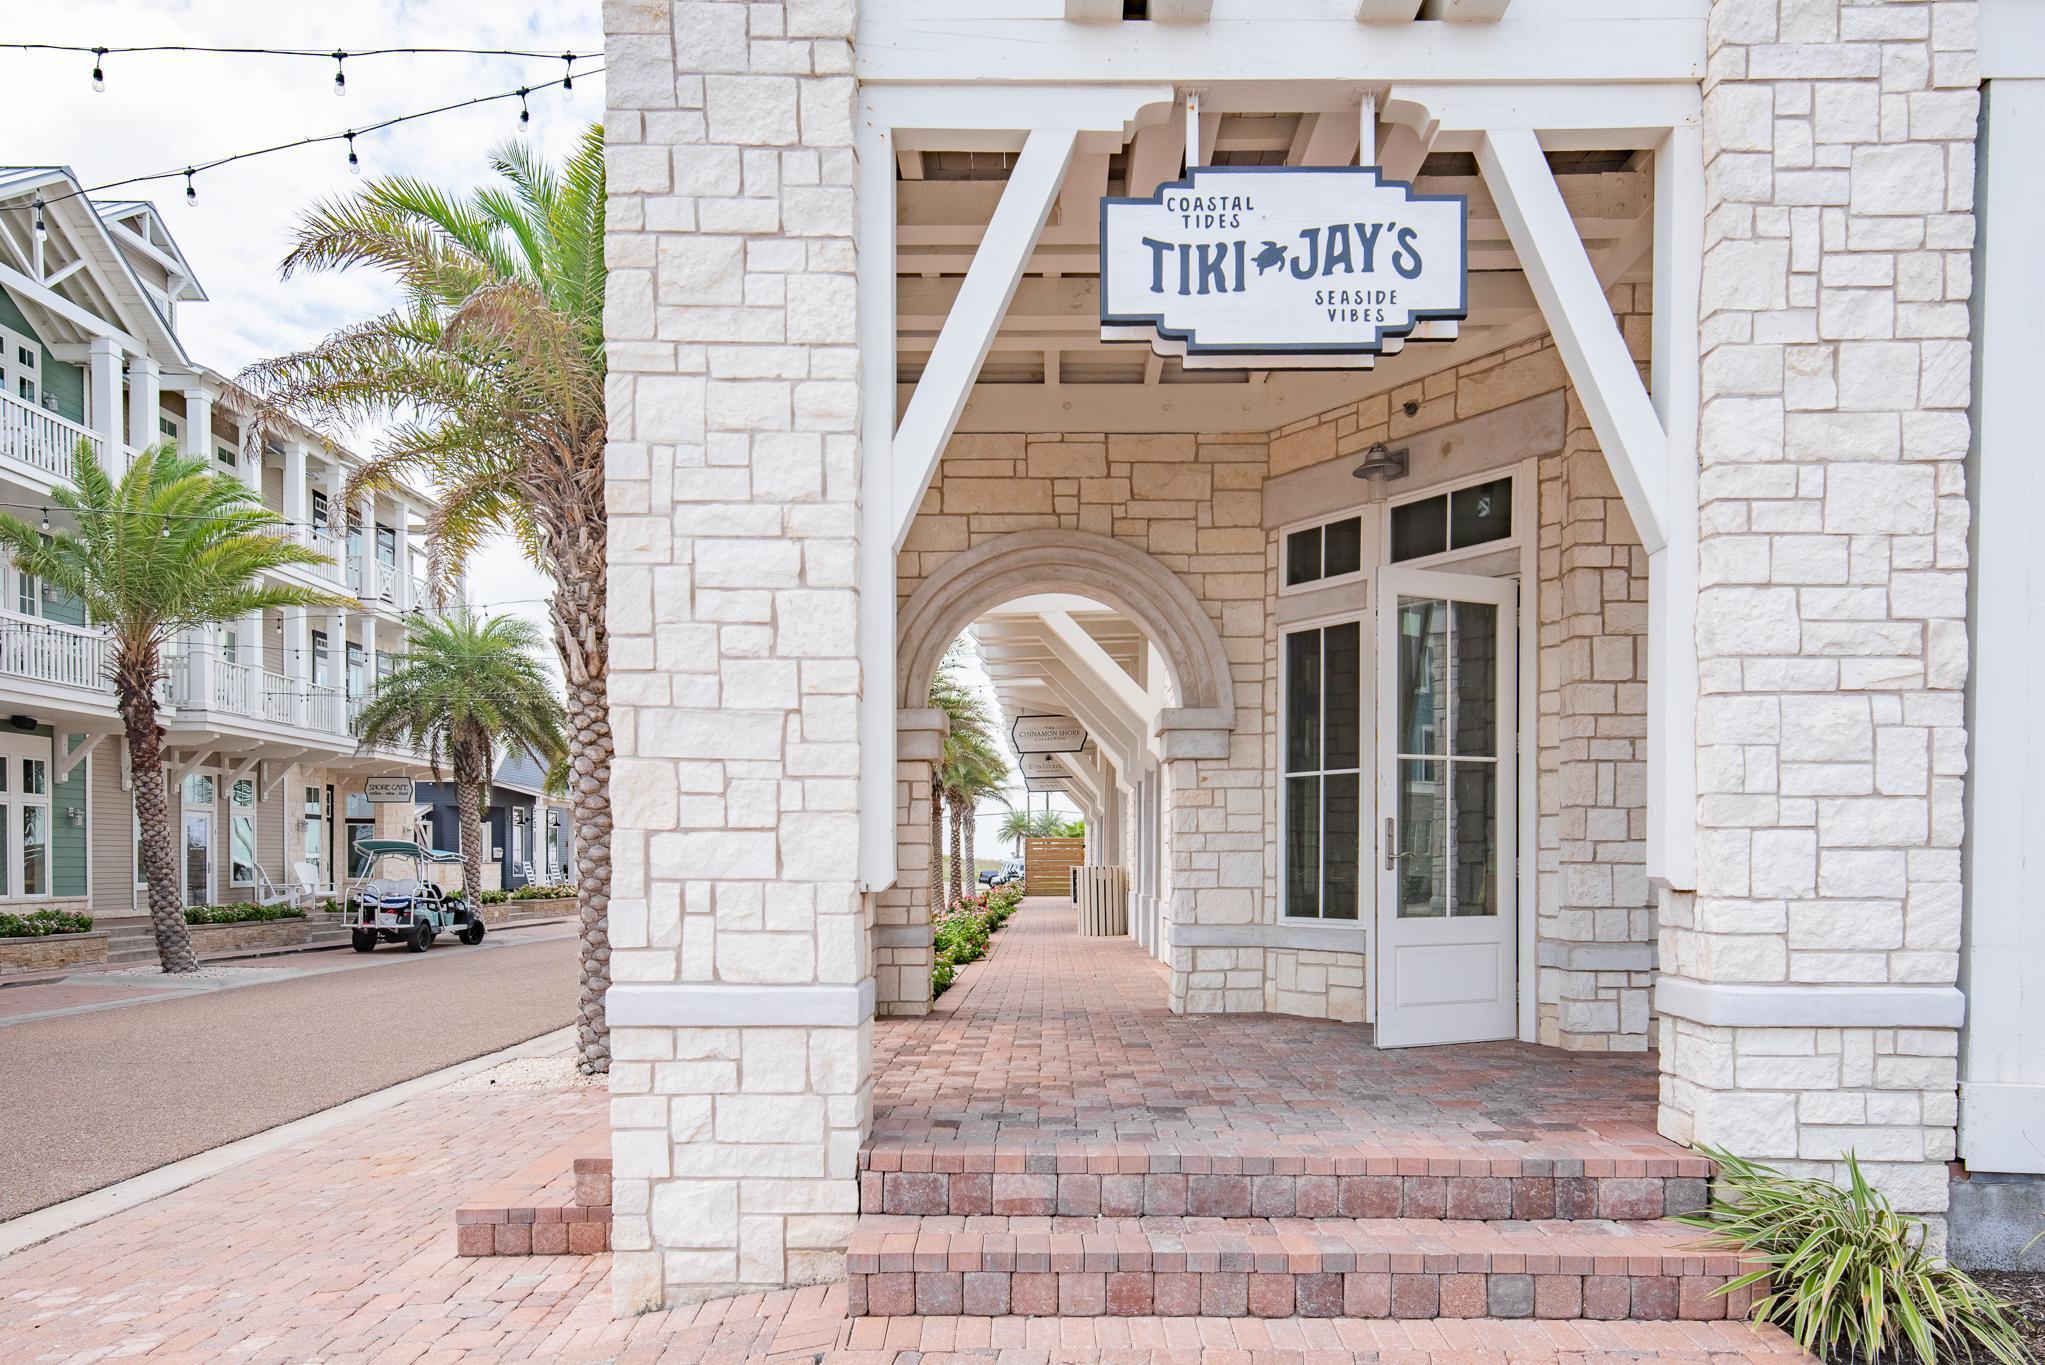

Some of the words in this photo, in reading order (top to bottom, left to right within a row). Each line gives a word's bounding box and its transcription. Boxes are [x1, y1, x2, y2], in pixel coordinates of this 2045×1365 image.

[1167, 196, 1255, 211] COASTAL
[1182, 213, 1240, 229] TIDES
[1142, 236, 1247, 295] TIKI
[1290, 222, 1423, 280] JAY'S
[1315, 290, 1398, 305] SEASIDE
[1328, 309, 1385, 323] VIBES
[1019, 730, 1057, 738] CINNAMON
